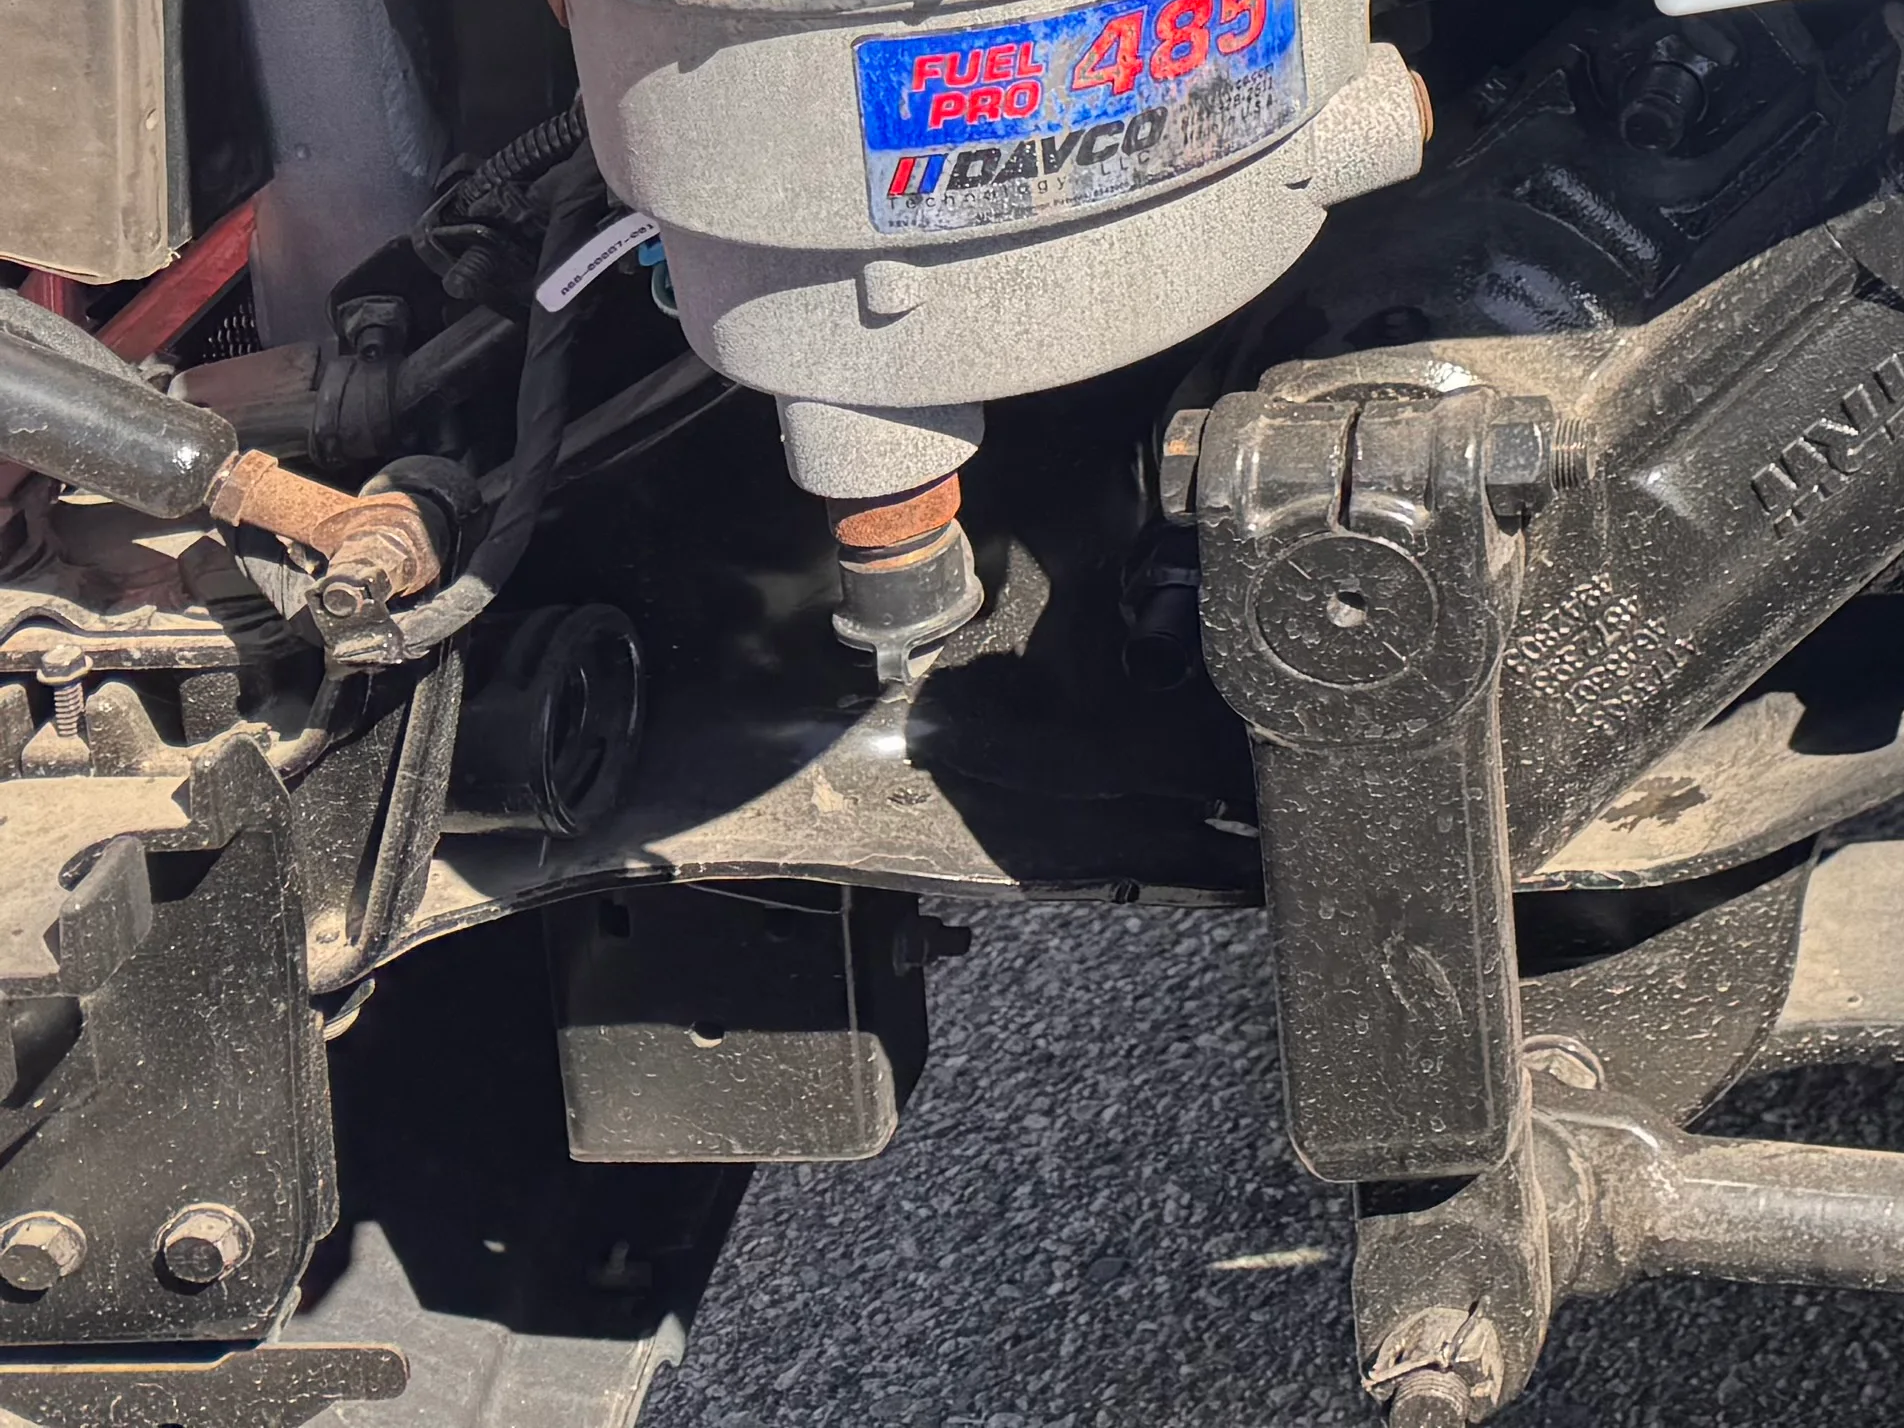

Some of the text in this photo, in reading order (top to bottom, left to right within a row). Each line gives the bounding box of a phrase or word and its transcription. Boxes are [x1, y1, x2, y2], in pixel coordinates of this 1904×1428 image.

[911, 40, 1047, 93] FUEL
[927, 79, 1042, 131] PRO
[945, 106, 1168, 192] DAVCO
